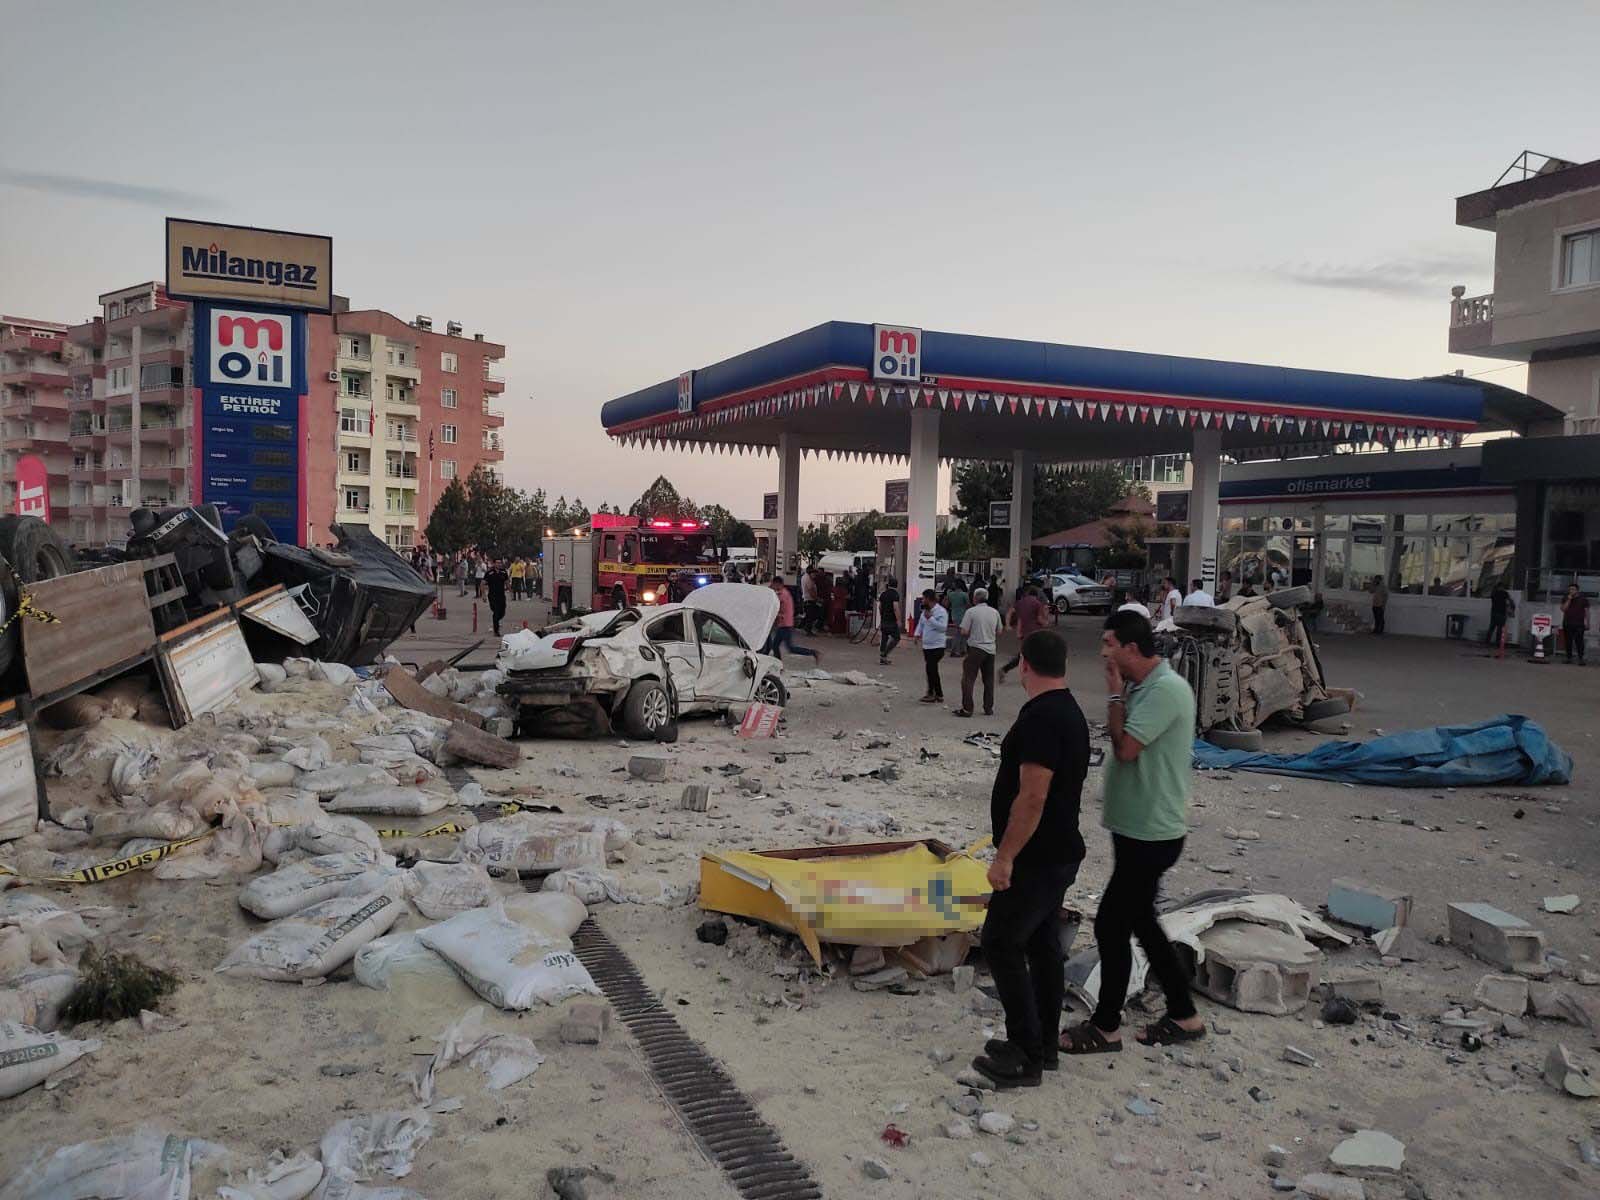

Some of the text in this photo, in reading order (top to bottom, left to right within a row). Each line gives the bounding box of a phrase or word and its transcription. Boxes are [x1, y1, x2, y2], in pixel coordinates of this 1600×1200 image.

[182, 243, 317, 286] Milangaz
[218, 315, 283, 351] m
[880, 330, 916, 354] m
[218, 351, 283, 382] oil
[880, 355, 916, 376] oil
[220, 395, 281, 407] EKTİREN
[223, 403, 279, 415] PETROL
[20, 480, 46, 520] ET
